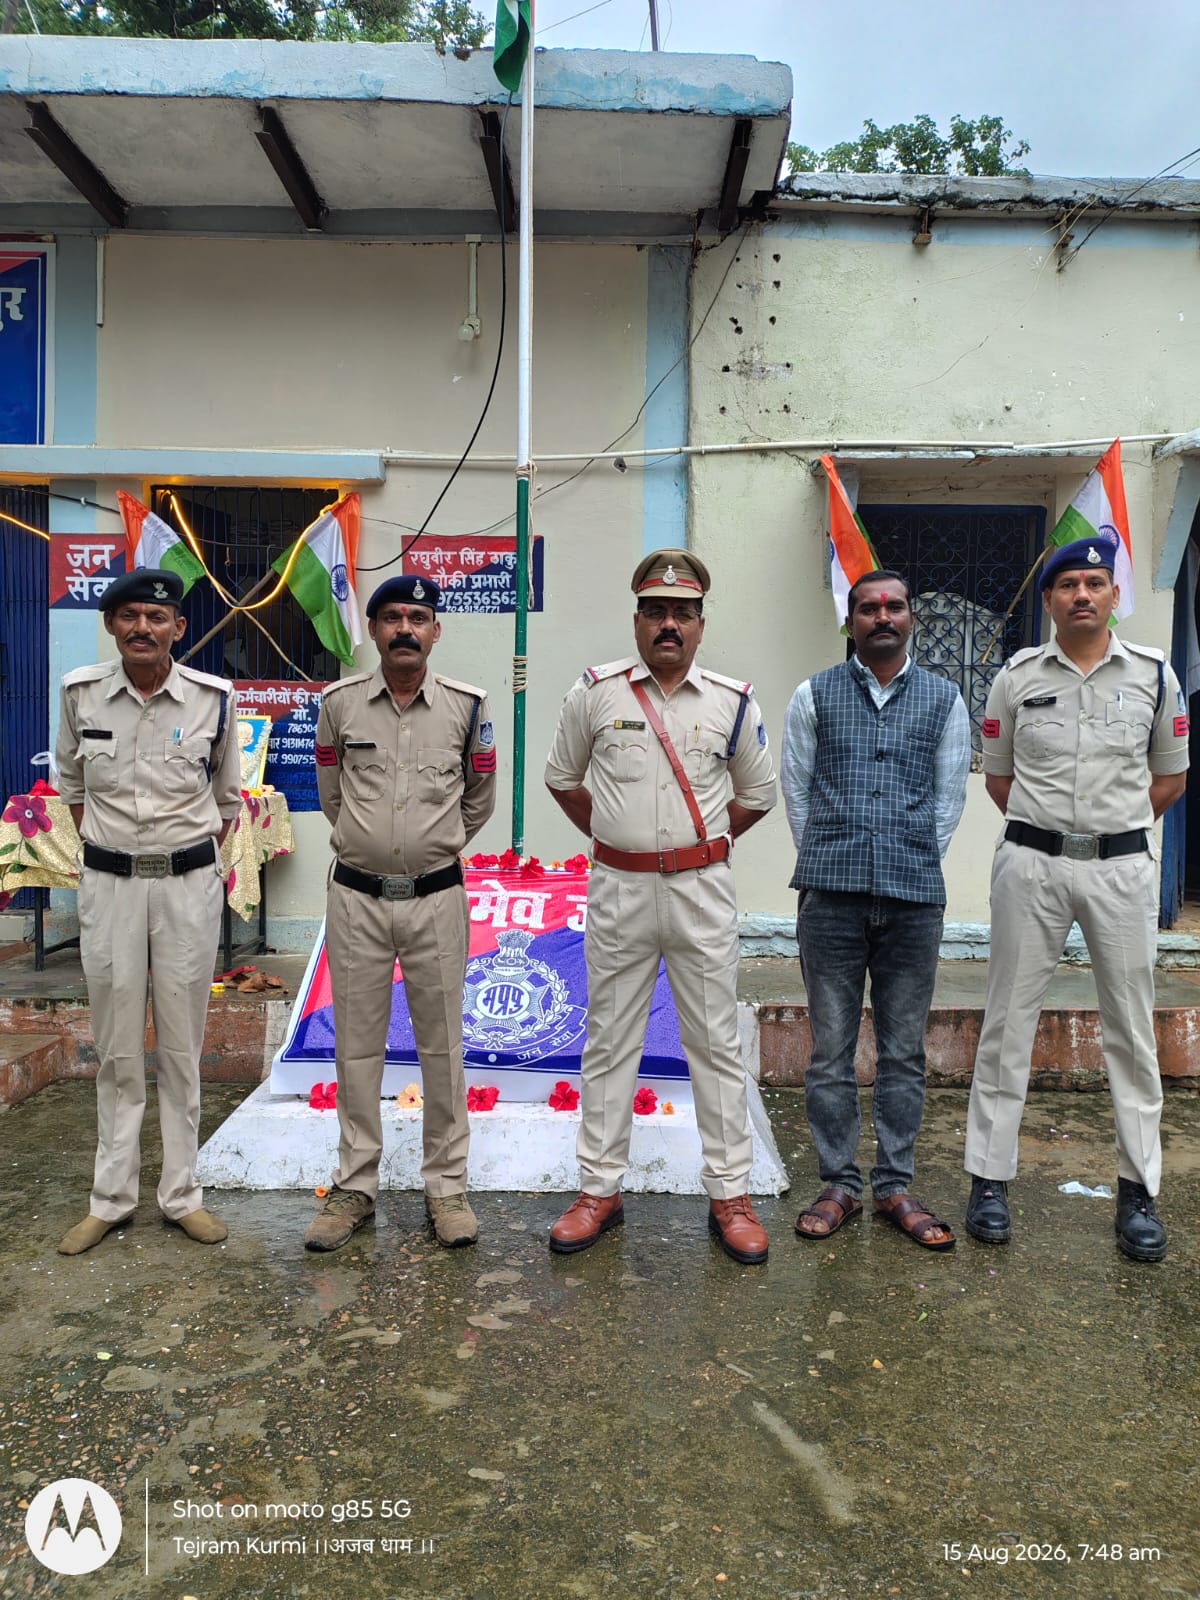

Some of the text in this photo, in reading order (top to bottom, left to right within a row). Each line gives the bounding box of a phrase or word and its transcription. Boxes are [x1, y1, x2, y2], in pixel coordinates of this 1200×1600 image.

[66, 544, 116, 570] जन
[409, 547, 517, 570] रघुवीर सिंह ठाकु
[469, 571, 512, 589] प्रभारी
[517, 1047, 542, 1060] जन
